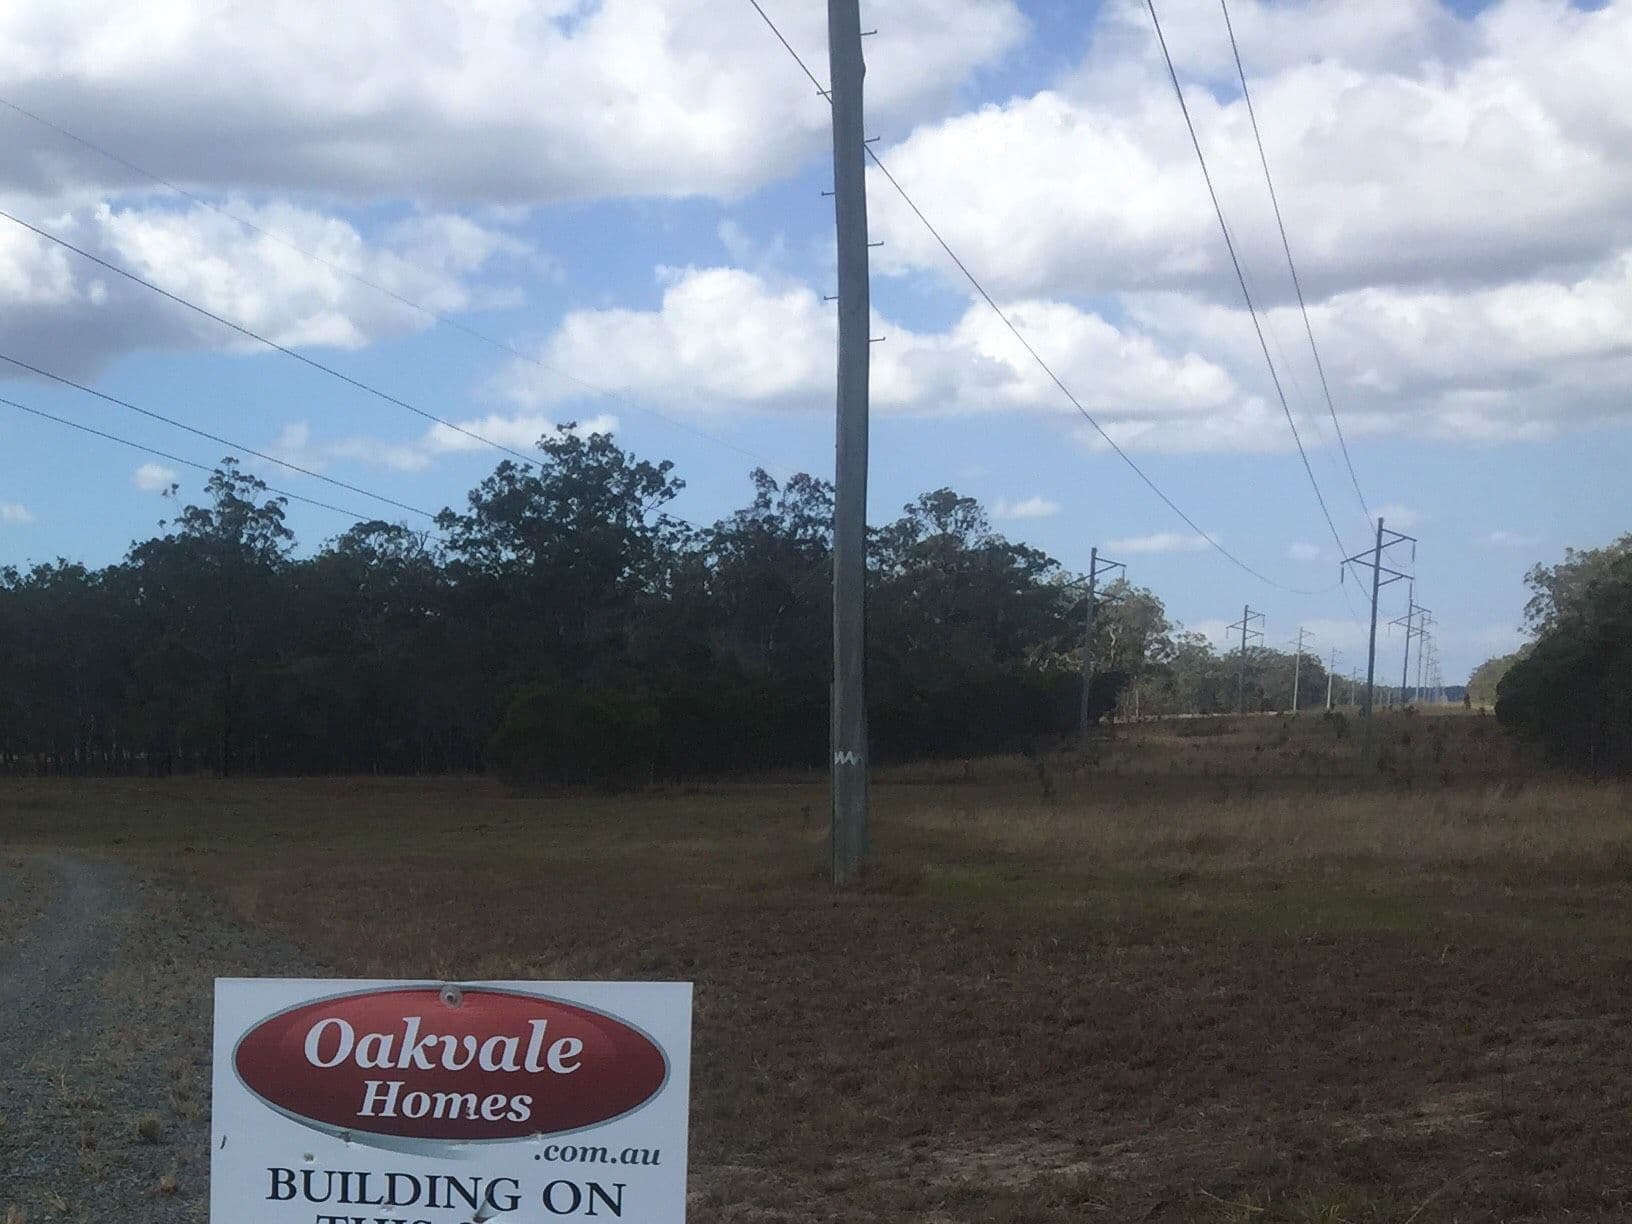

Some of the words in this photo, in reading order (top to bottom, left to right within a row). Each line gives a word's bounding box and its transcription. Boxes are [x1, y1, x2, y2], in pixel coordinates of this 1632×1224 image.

[304, 1016, 583, 1074] Oakvale
[356, 1080, 533, 1122] Homes
[534, 1141, 662, 1165] .com.au
[266, 1167, 522, 1211] BUILDING
[542, 1179, 627, 1217] ON
